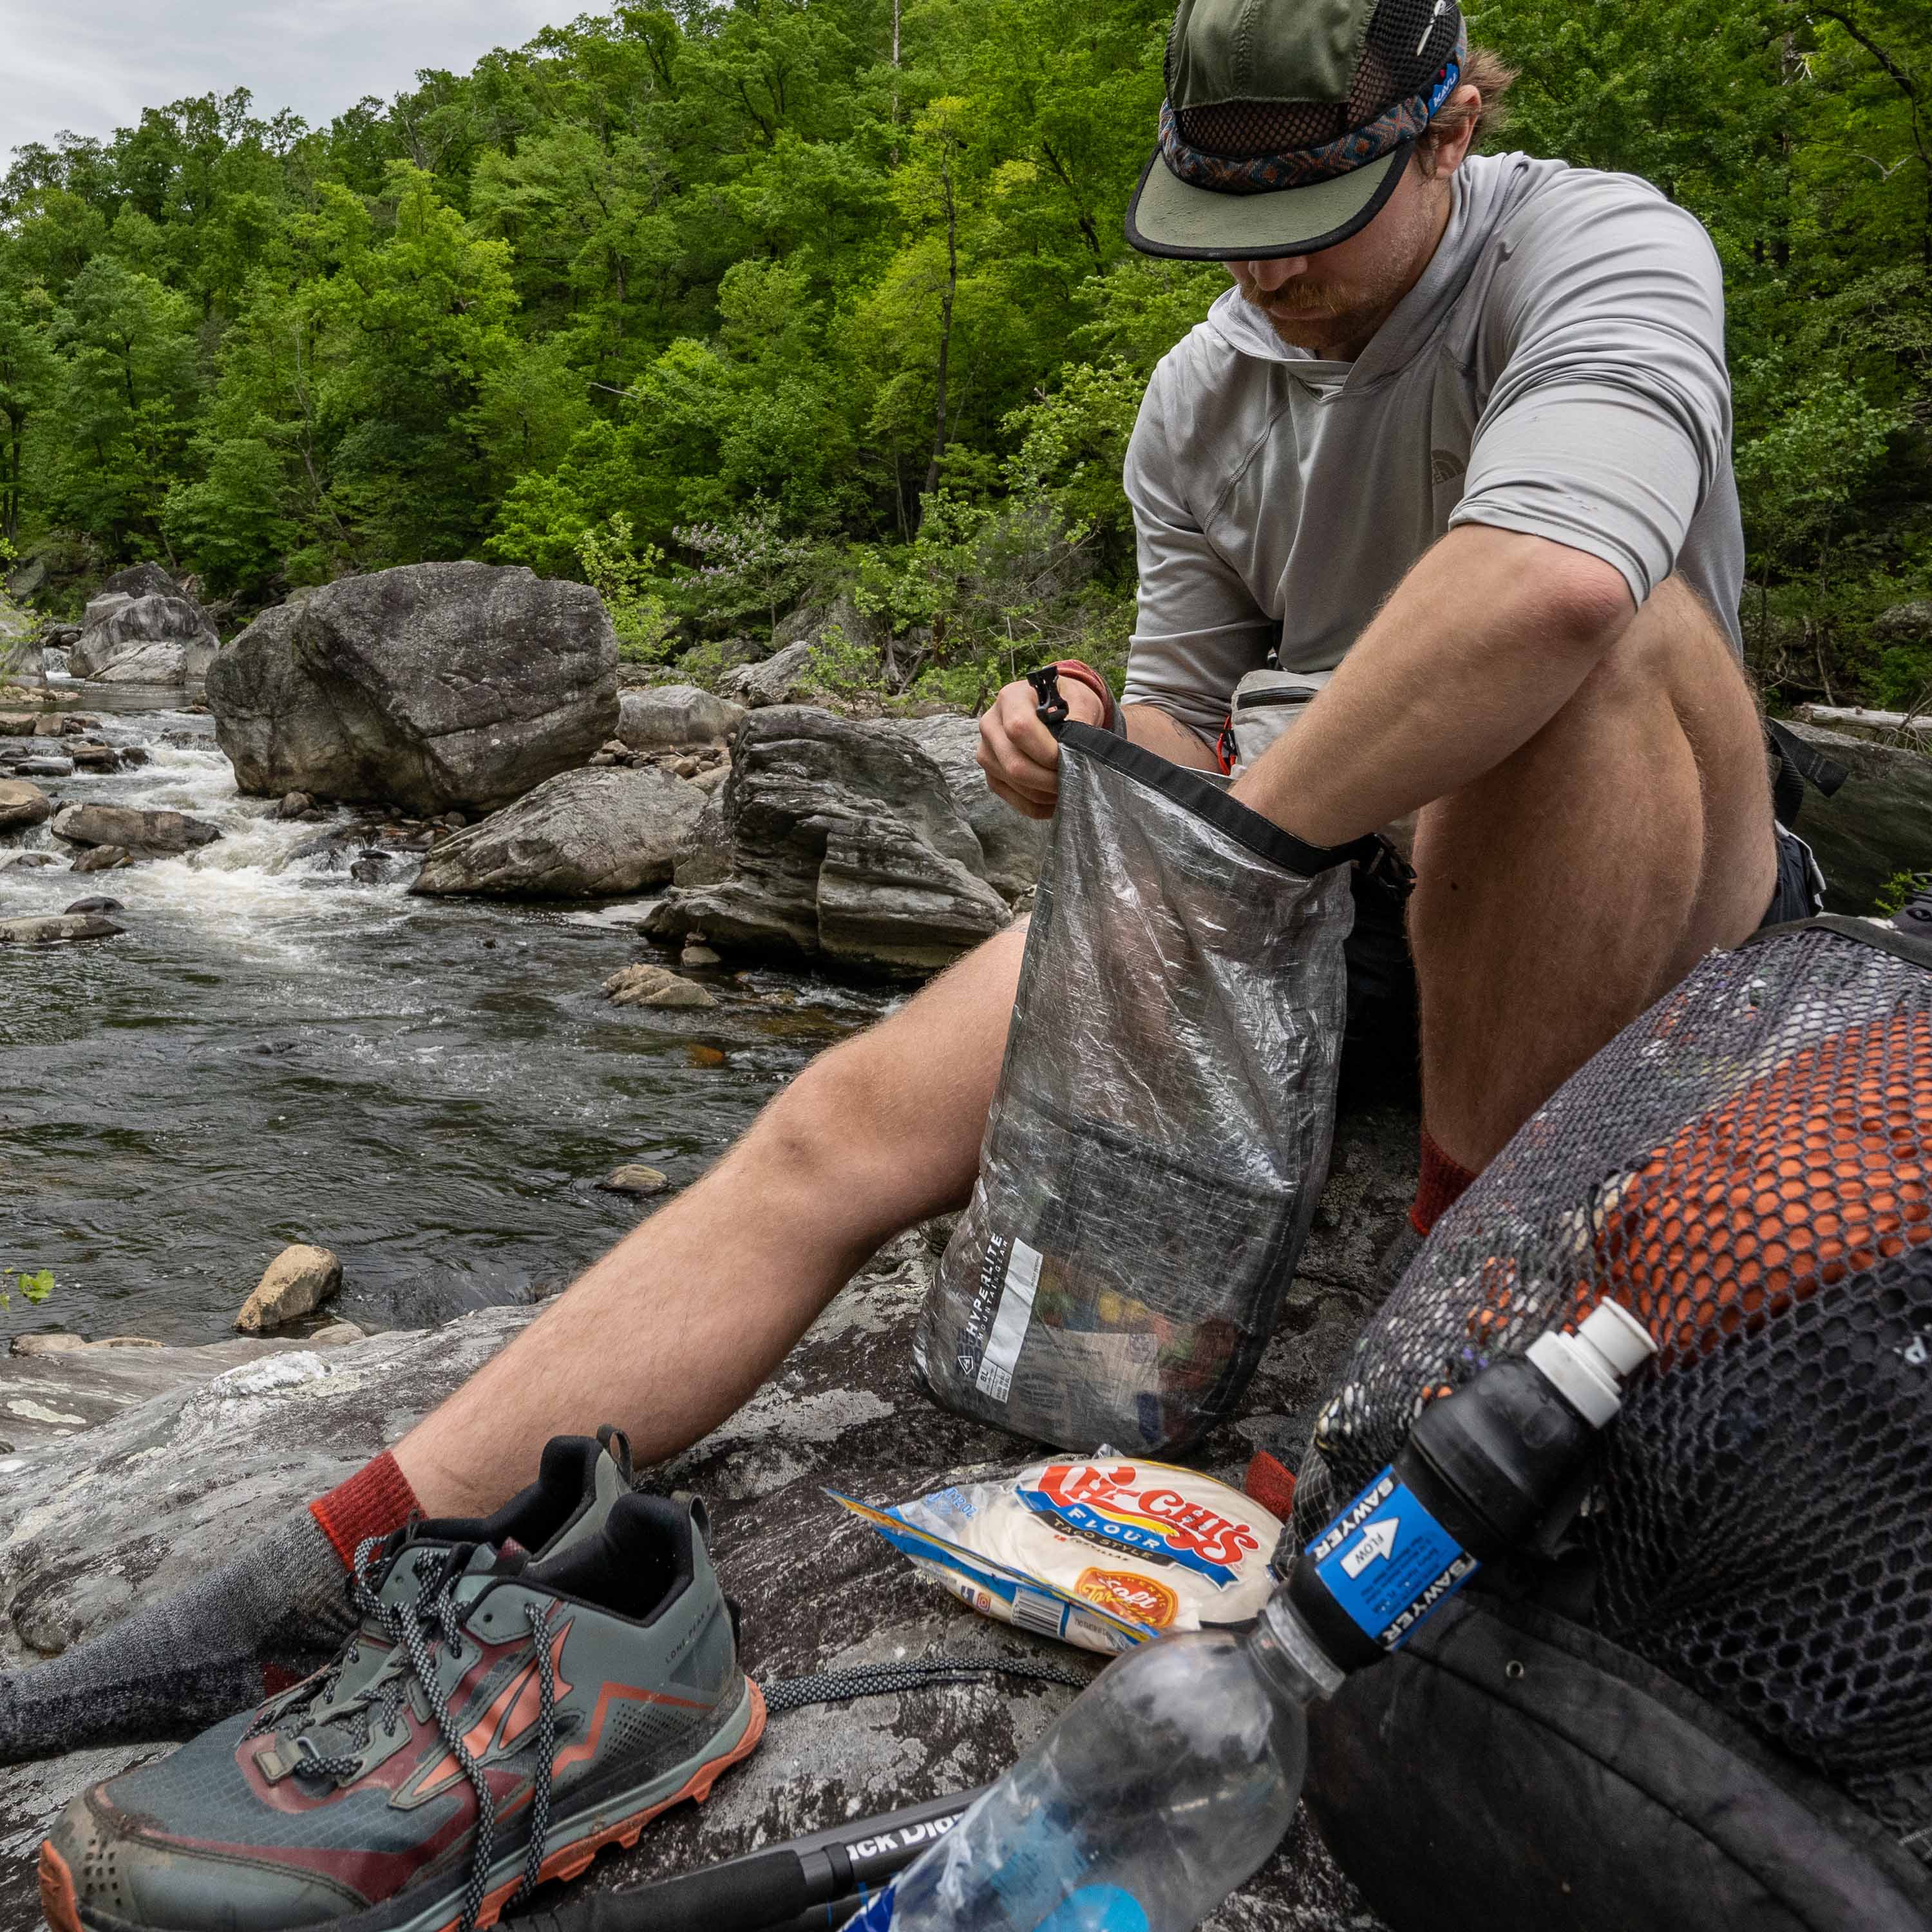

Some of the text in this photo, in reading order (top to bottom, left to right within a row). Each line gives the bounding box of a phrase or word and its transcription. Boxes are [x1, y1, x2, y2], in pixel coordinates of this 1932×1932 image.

[1434, 72, 1456, 108] KAVU
[966, 1233, 1003, 1336] HYPERLITE
[978, 1240, 1008, 1341] MOUNTAIN GEAR
[980, 1371, 989, 1382] 8L
[1054, 1519, 1095, 1539] TACO
[1099, 1539, 1153, 1558] STYLE
[1068, 1506, 1160, 1548] FLOUR
[1314, 1477, 1394, 1561] SAWYER
[1355, 1533, 1384, 1564] FLOW
[1382, 1559, 1466, 1642] SAWYER
